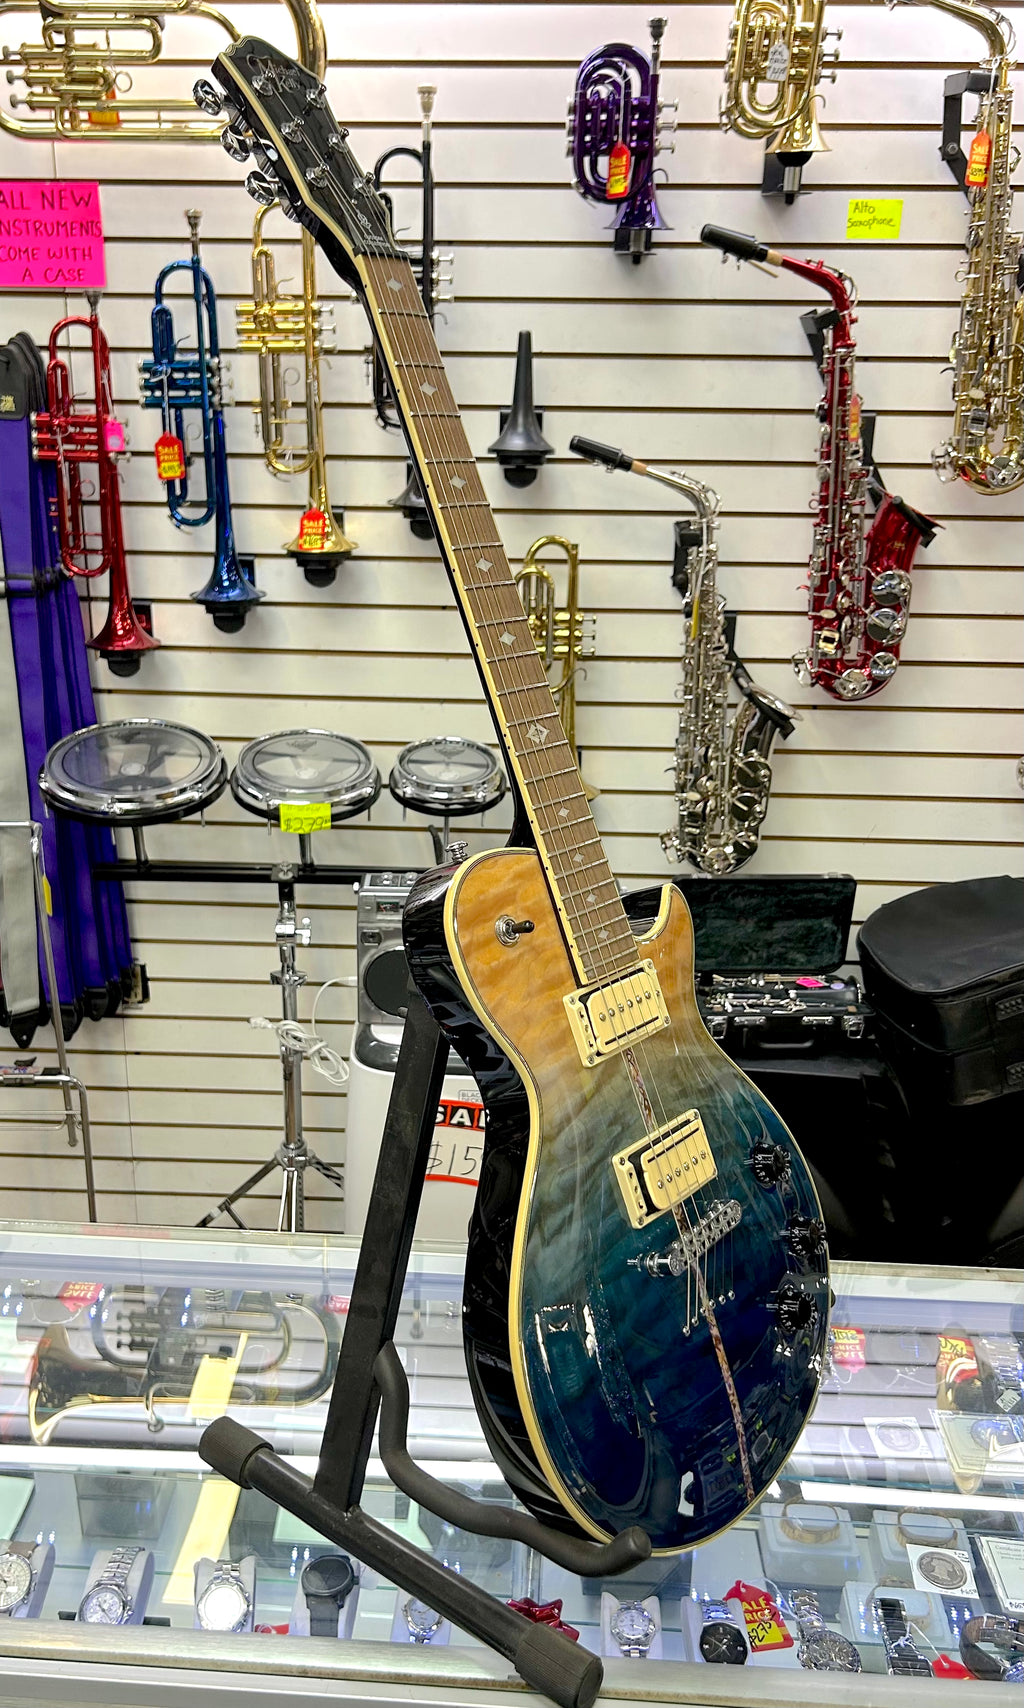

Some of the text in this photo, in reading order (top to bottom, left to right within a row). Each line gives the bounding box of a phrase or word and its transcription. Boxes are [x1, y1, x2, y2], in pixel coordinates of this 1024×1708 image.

[973, 144, 989, 154] SALE
[0, 189, 92, 210] ALL NEW
[853, 201, 876, 214] Alto
[0, 219, 103, 238] NSTRUMENTS
[0, 246, 93, 263] COME WITH
[22, 267, 85, 283] A CASE
[158, 444, 179, 455] SALE
[303, 519, 323, 527] SALE
[742, 1596, 770, 1610] ALE
[744, 1610, 773, 1621] RICE
